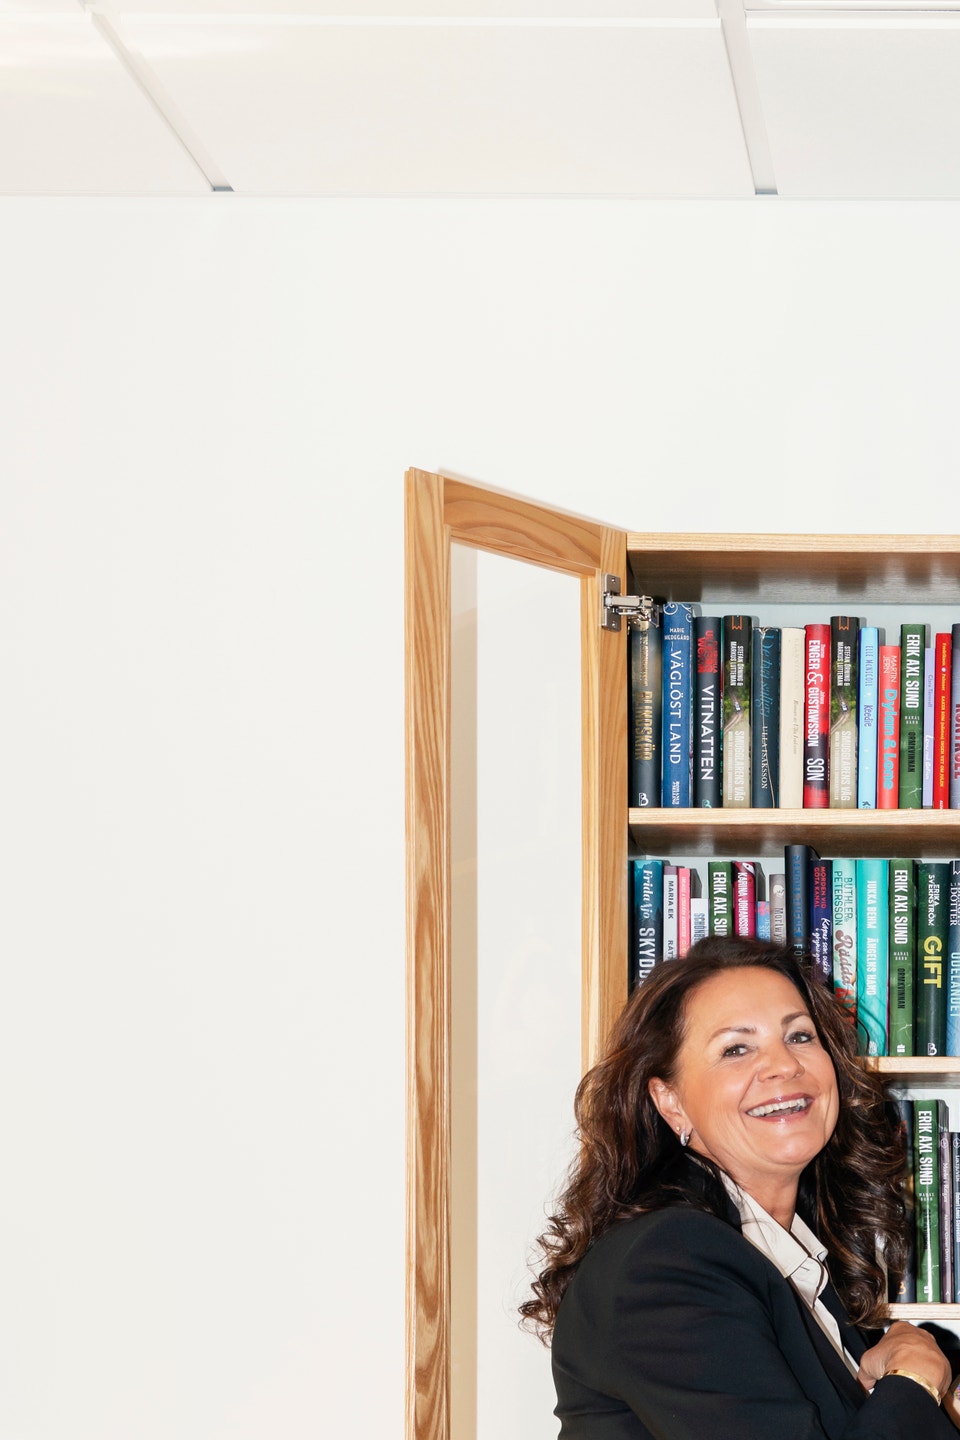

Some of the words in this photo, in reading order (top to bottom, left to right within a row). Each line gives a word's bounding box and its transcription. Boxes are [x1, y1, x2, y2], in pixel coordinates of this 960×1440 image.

[808, 640, 821, 670] ENGER
[906, 635, 921, 656] ERIK
[807, 671, 823, 686] &
[882, 655, 891, 674] JERN
[889, 655, 898, 683] MARTIN
[906, 659, 920, 679] AXL
[669, 650, 684, 719] VÄGLÖST
[905, 680, 920, 709] SUND
[807, 687, 820, 748] GUSTAWSSON
[864, 704, 875, 728] Keedie
[881, 688, 898, 736] Dylan
[670, 724, 682, 765] LAND
[700, 685, 714, 781] VITNATTEN
[734, 731, 745, 782] SMUGGLARENS
[806, 758, 825, 781] SON
[841, 731, 852, 782] SMUGGLARENS
[883, 752, 897, 790] Lone
[734, 785, 748, 801] VÄG
[841, 785, 854, 801] VÄG
[667, 880, 675, 906] MARIA
[737, 872, 748, 897] KARINA
[867, 880, 877, 905] JUKKA
[894, 869, 909, 893] ERIK
[834, 870, 843, 926] PETERSSON
[844, 877, 853, 919] BUTHLER
[894, 894, 908, 915] AXL
[667, 908, 675, 920] EK
[738, 898, 750, 937] JOHANSSON
[894, 916, 908, 945] SUND
[834, 930, 854, 986] Rädda
[866, 937, 880, 972] ÄNGELNS
[924, 935, 943, 988] GIFT
[866, 974, 877, 996] HAND
[918, 1110, 934, 1134] ERIK
[918, 1135, 933, 1155] AXL
[918, 1156, 933, 1185] SUND
